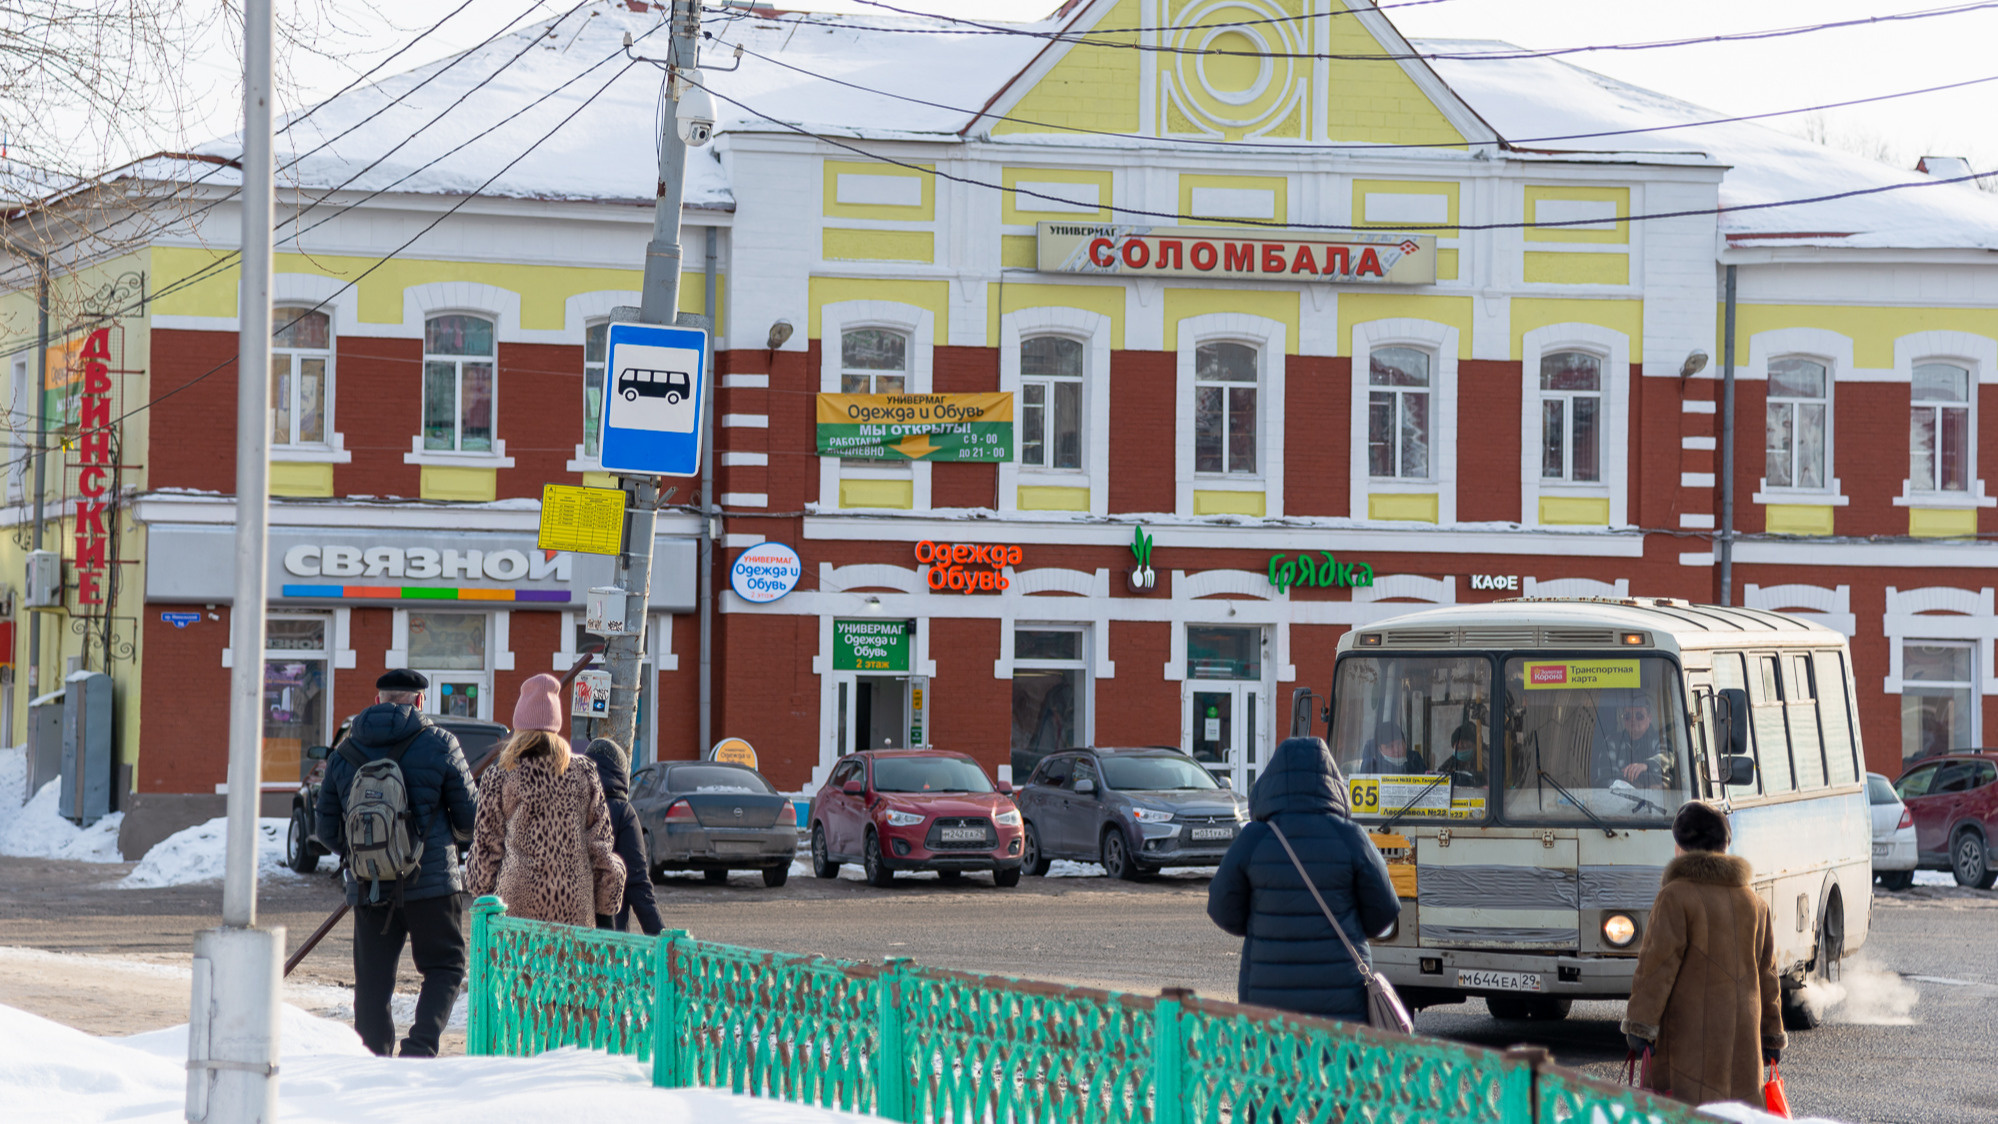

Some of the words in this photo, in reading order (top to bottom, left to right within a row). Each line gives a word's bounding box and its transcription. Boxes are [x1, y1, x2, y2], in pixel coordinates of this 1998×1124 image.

[1050, 225, 1117, 237] УНИВЕРМАГ
[1089, 237, 1384, 277] СОЛОМБАЛА
[887, 395, 946, 404] УНИВЕРМАГ
[848, 404, 915, 422] Одежда
[920, 407, 929, 419] и
[934, 403, 984, 421] Обувь
[860, 424, 887, 436] МЫ
[971, 433, 978, 444] 9
[986, 433, 998, 444] 00
[972, 447, 984, 457] 21
[993, 447, 1005, 457] 00
[74, 327, 112, 605] ДВИНСКИЕ
[743, 555, 793, 564] УНИВЕРМАГ
[915, 540, 1023, 570] Одежда
[284, 544, 572, 581] СВЯЗНОЙ
[735, 563, 788, 578] Одежда
[790, 567, 799, 577] и
[747, 577, 787, 592] Обувь
[927, 565, 1010, 595] Обувь
[1471, 574, 1519, 590] КАФЕ
[838, 623, 905, 635] УНИВЕРМАГ
[844, 634, 888, 646] Одежда
[854, 645, 888, 658] Обувь
[856, 658, 862, 668] 2
[864, 660, 890, 669] этаж
[1570, 665, 1634, 675] Транспортная
[1534, 672, 1563, 681] Корона
[1571, 675, 1597, 684] карта
[1351, 785, 1378, 806] 65
[1428, 808, 1447, 817] №22
[1463, 972, 1518, 988] М644ЕА
[1522, 975, 1536, 985] 29
